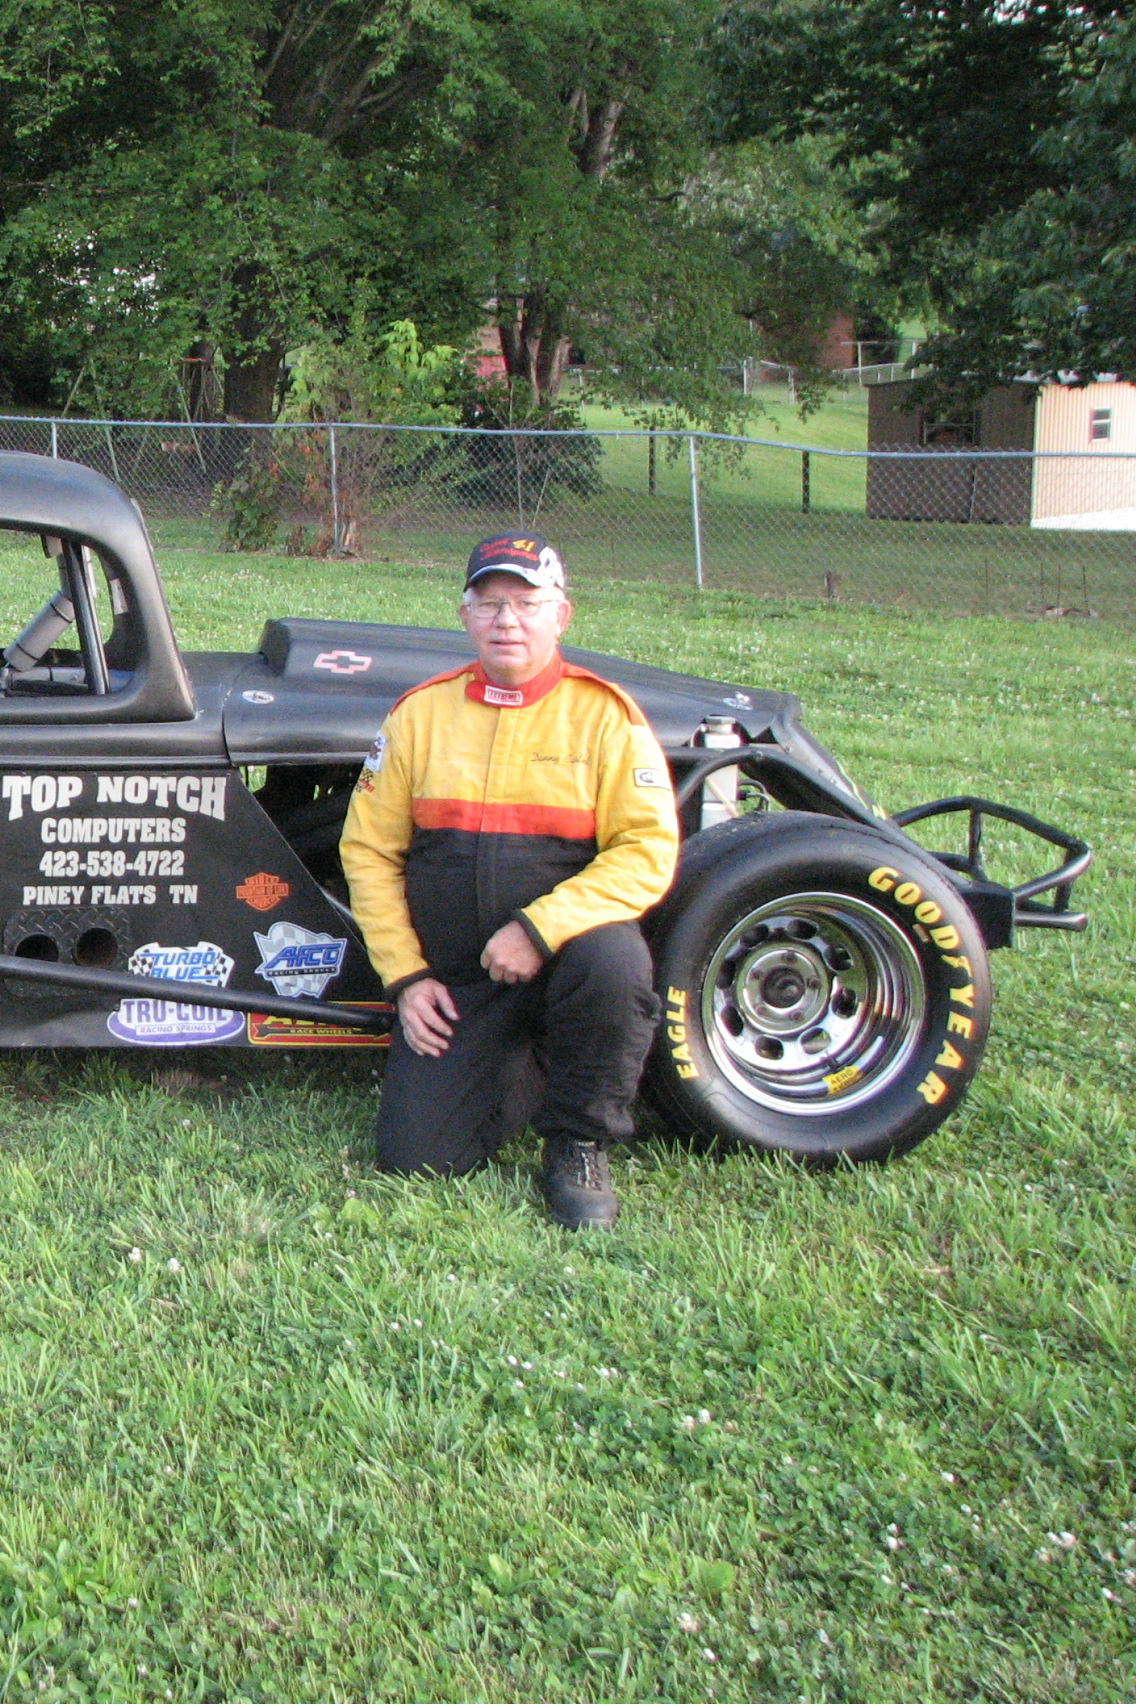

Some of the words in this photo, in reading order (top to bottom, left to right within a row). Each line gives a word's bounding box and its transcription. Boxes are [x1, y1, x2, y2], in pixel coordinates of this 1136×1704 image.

[2, 775, 83, 821] TOP
[96, 775, 227, 821] NOTCH
[40, 817, 186, 843] COMPUTERS
[39, 850, 185, 877] 423-538-4722
[22, 885, 85, 905] PINEY
[91, 885, 157, 905] FLATS
[169, 884, 198, 904] TN
[139, 952, 216, 965] TURBO
[264, 942, 343, 970] AFCO
[149, 967, 219, 980] BLUE
[868, 867, 975, 1104] GOODYEAR
[123, 1000, 227, 1023] TRU-COIL
[140, 1025, 173, 1034] RACING
[176, 1024, 212, 1033] SPRINGS
[666, 986, 699, 1079] EAGLE
